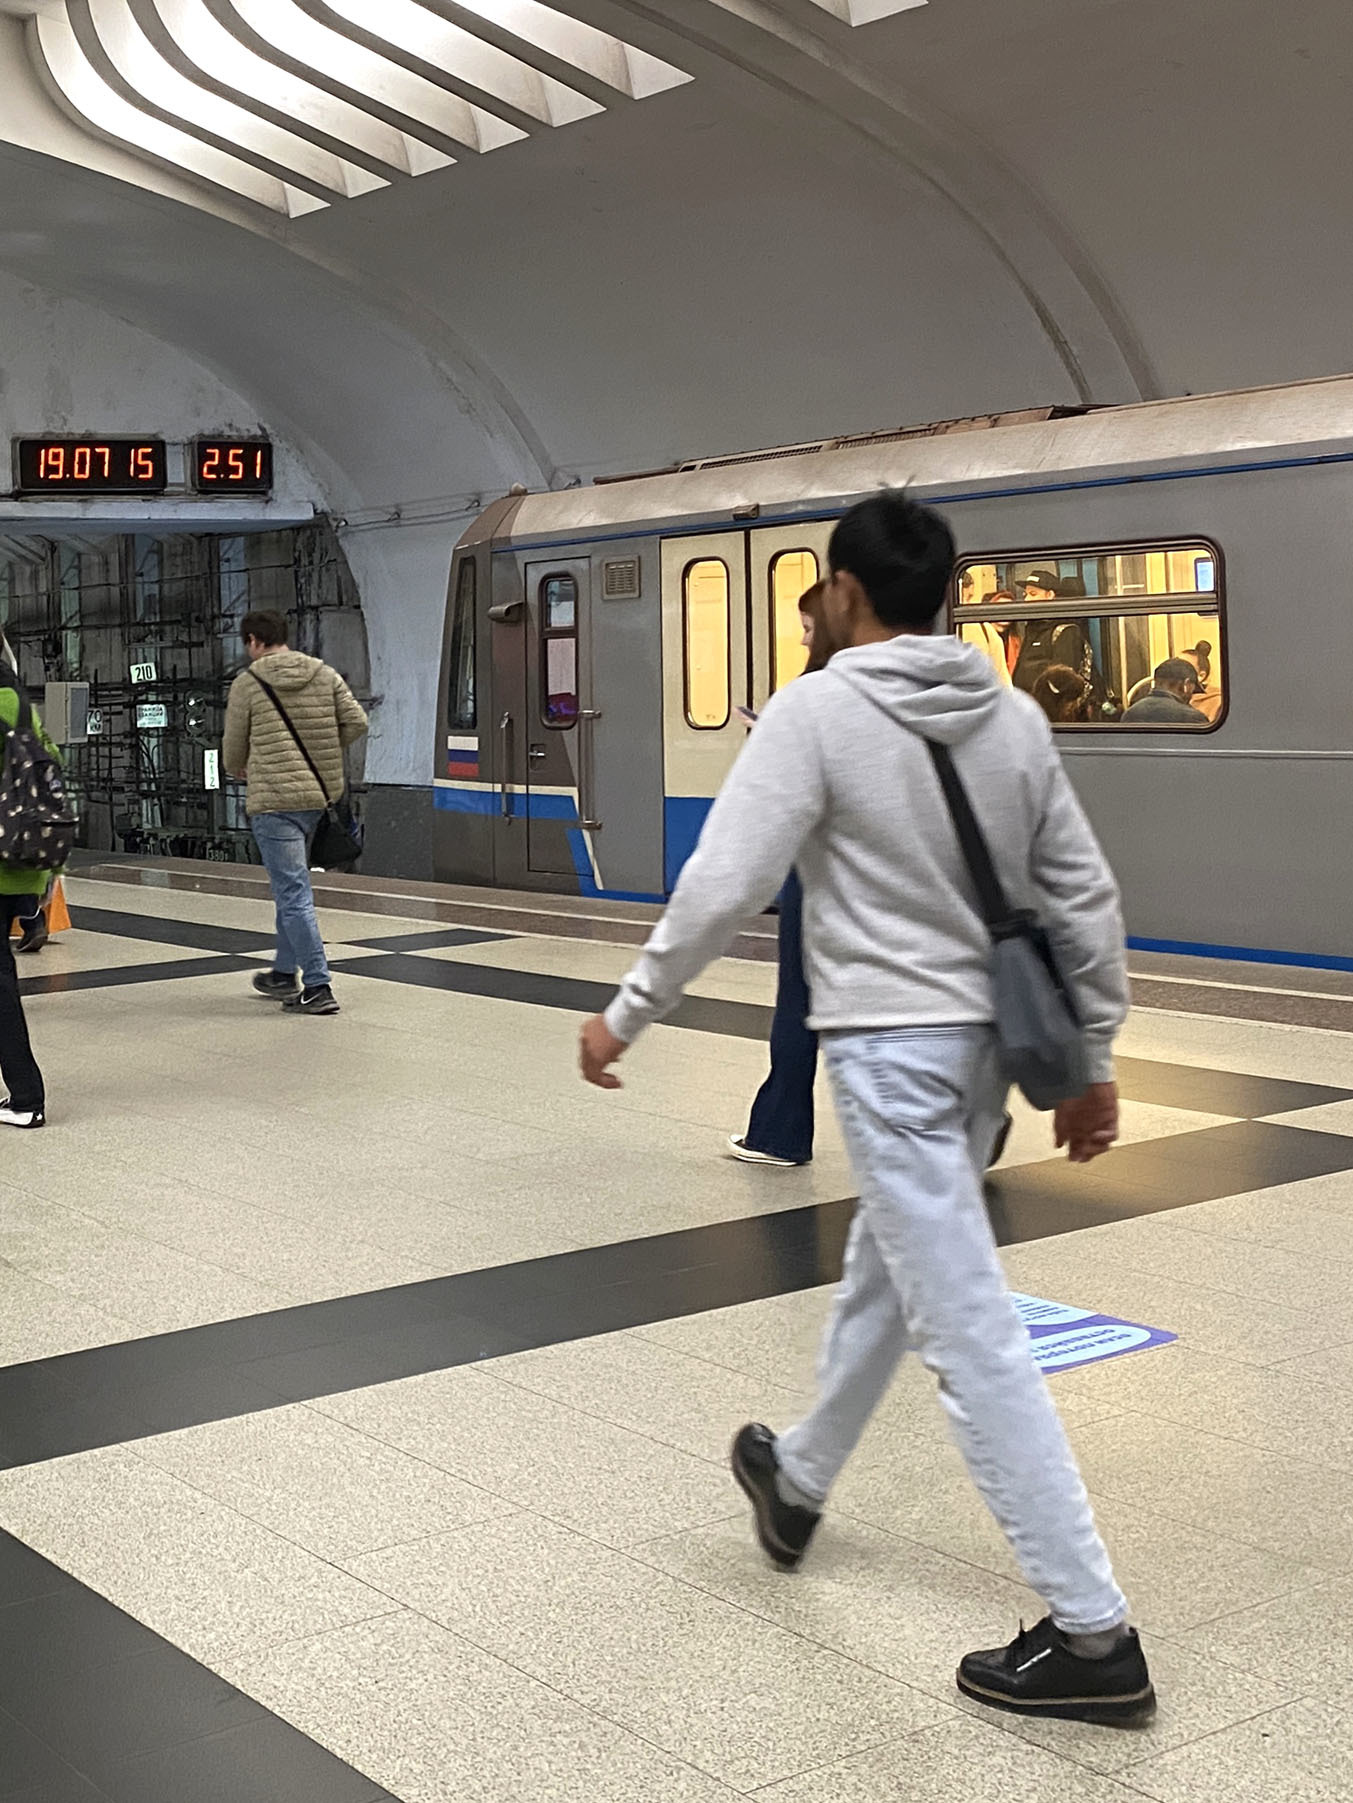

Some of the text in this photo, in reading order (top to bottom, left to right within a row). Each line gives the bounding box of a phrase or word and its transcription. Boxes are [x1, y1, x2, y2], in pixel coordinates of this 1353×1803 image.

[129, 447, 154, 479] 15
[202, 448, 262, 480] 2.51
[134, 664, 153, 681] 210
[87, 709, 102, 723] 70
